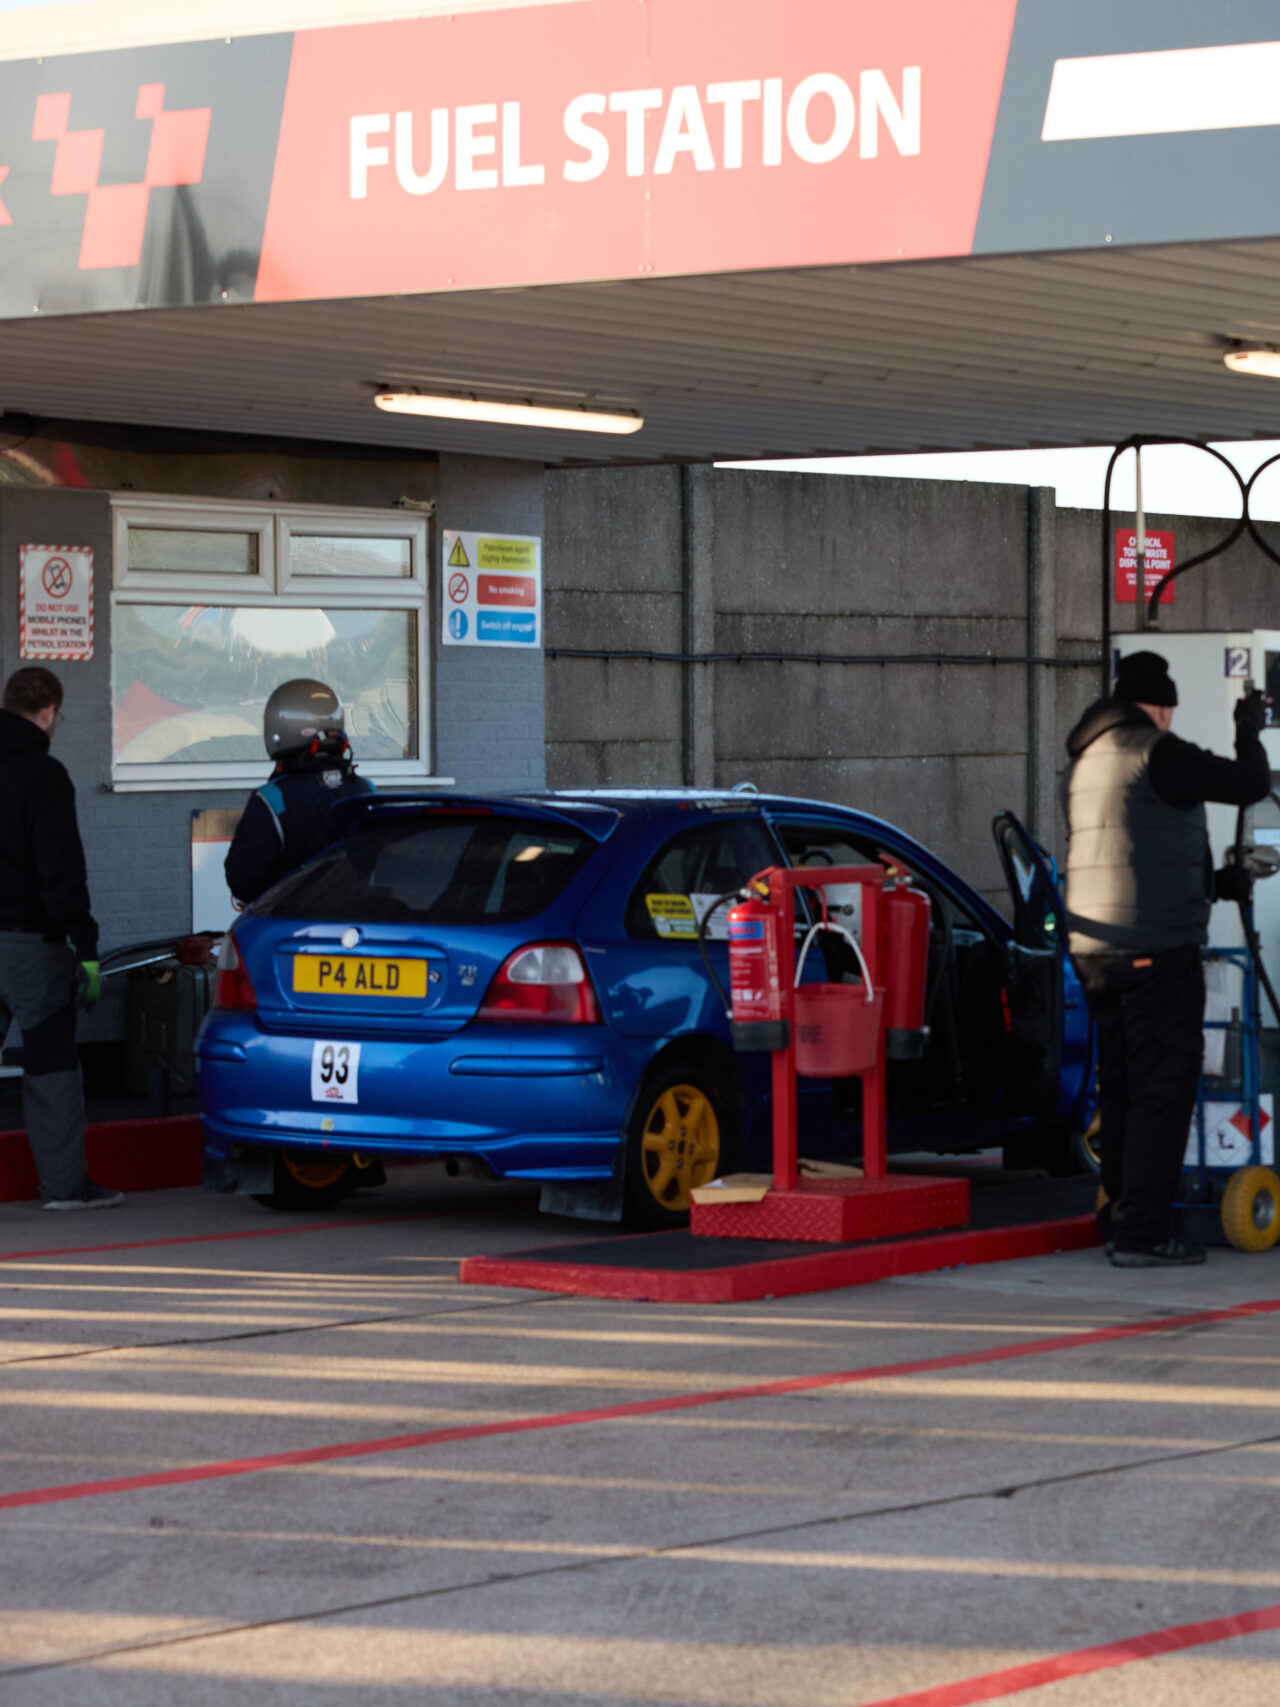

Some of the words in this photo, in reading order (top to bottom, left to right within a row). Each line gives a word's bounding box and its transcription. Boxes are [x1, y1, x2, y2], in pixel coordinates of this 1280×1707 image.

[349, 101, 545, 199] FUEL
[562, 65, 922, 183] STATION
[1145, 548, 1168, 559] WASTE
[1151, 559, 1171, 570] POINT
[488, 584, 498, 594] No
[499, 586, 525, 597] smoking
[35, 603, 46, 612] DO
[48, 603, 62, 612] NOT
[64, 604, 79, 613] USE
[27, 616, 55, 625] MOBILE
[57, 616, 87, 625] PHONES
[31, 628, 57, 637] WHILST
[59, 628, 67, 637] IN
[69, 628, 82, 637] THE
[27, 640, 55, 649] PETROL
[57, 640, 86, 649] STATION
[1230, 648, 1249, 676] 2
[1265, 707, 1273, 725] 2
[319, 960, 347, 988] P4
[354, 963, 400, 991] ALD
[320, 1045, 350, 1084] 93
